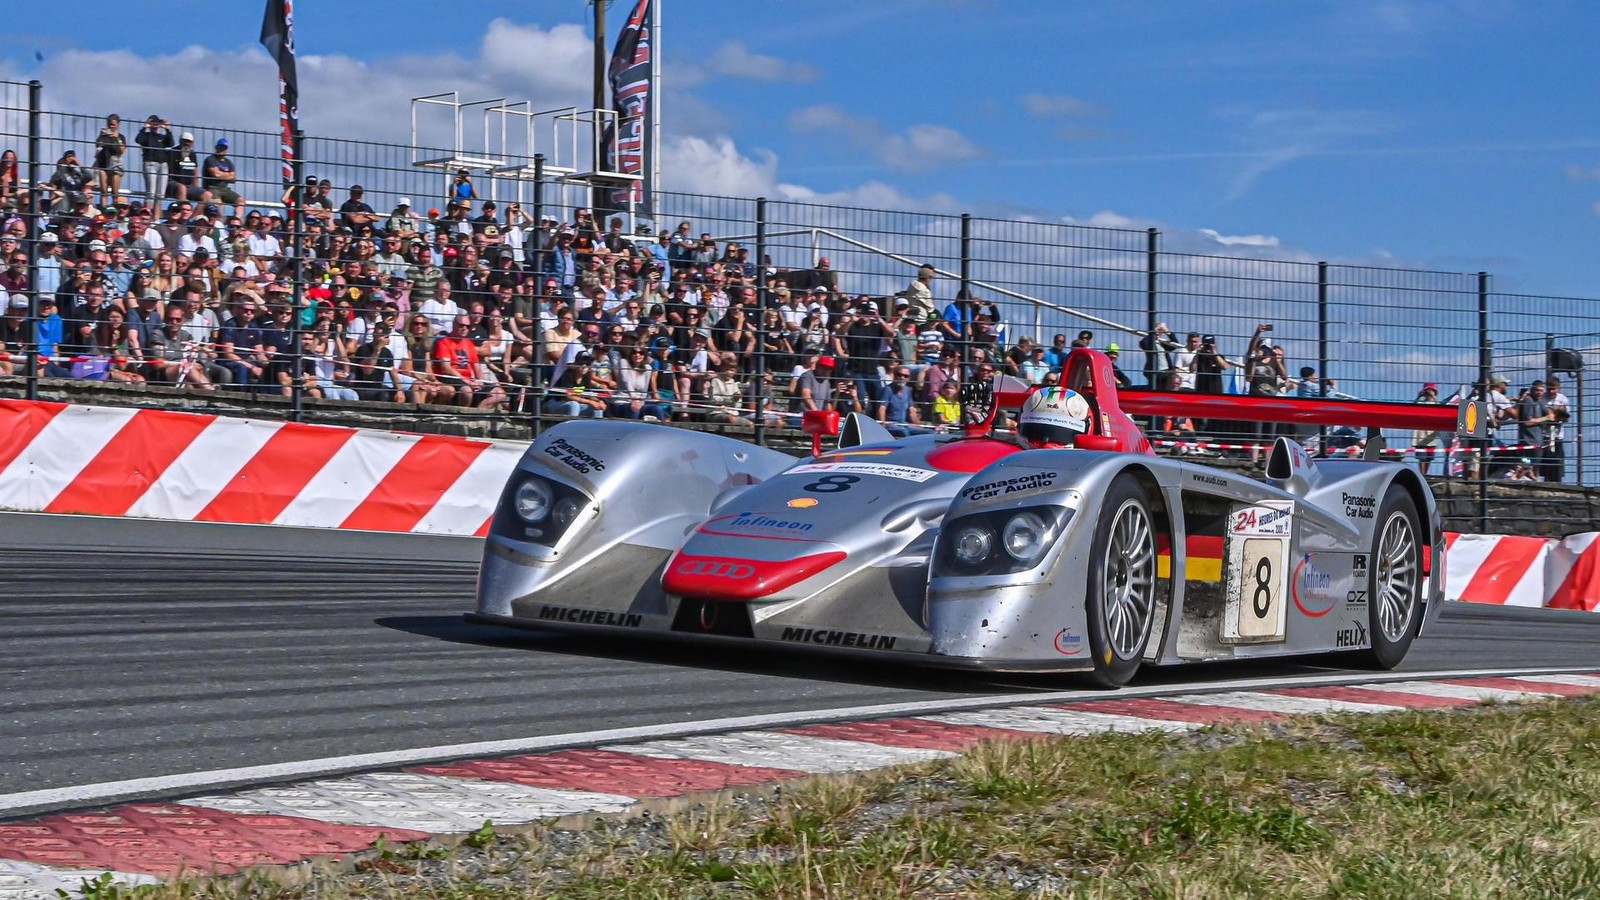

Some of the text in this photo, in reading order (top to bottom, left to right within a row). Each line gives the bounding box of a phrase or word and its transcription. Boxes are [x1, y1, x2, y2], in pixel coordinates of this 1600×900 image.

[545, 446, 590, 474] Car Audio
[551, 438, 605, 472] Panasonic
[803, 475, 861, 493] 8
[963, 472, 1057, 498] Panasonic
[970, 480, 1053, 501] Car Audio
[1193, 474, 1228, 487] www.audi.com
[1342, 492, 1376, 507] Panasonic
[730, 515, 814, 531] Infineon
[1233, 509, 1257, 532] 24
[1346, 506, 1374, 519] Car Audio
[1353, 555, 1367, 569] R
[1253, 556, 1271, 618] 8
[1303, 564, 1331, 589] Infineon
[1346, 590, 1367, 603] OZ
[540, 606, 642, 628] MICHELIN
[781, 627, 897, 649] MICHELIN
[1336, 621, 1368, 648] HELIX
